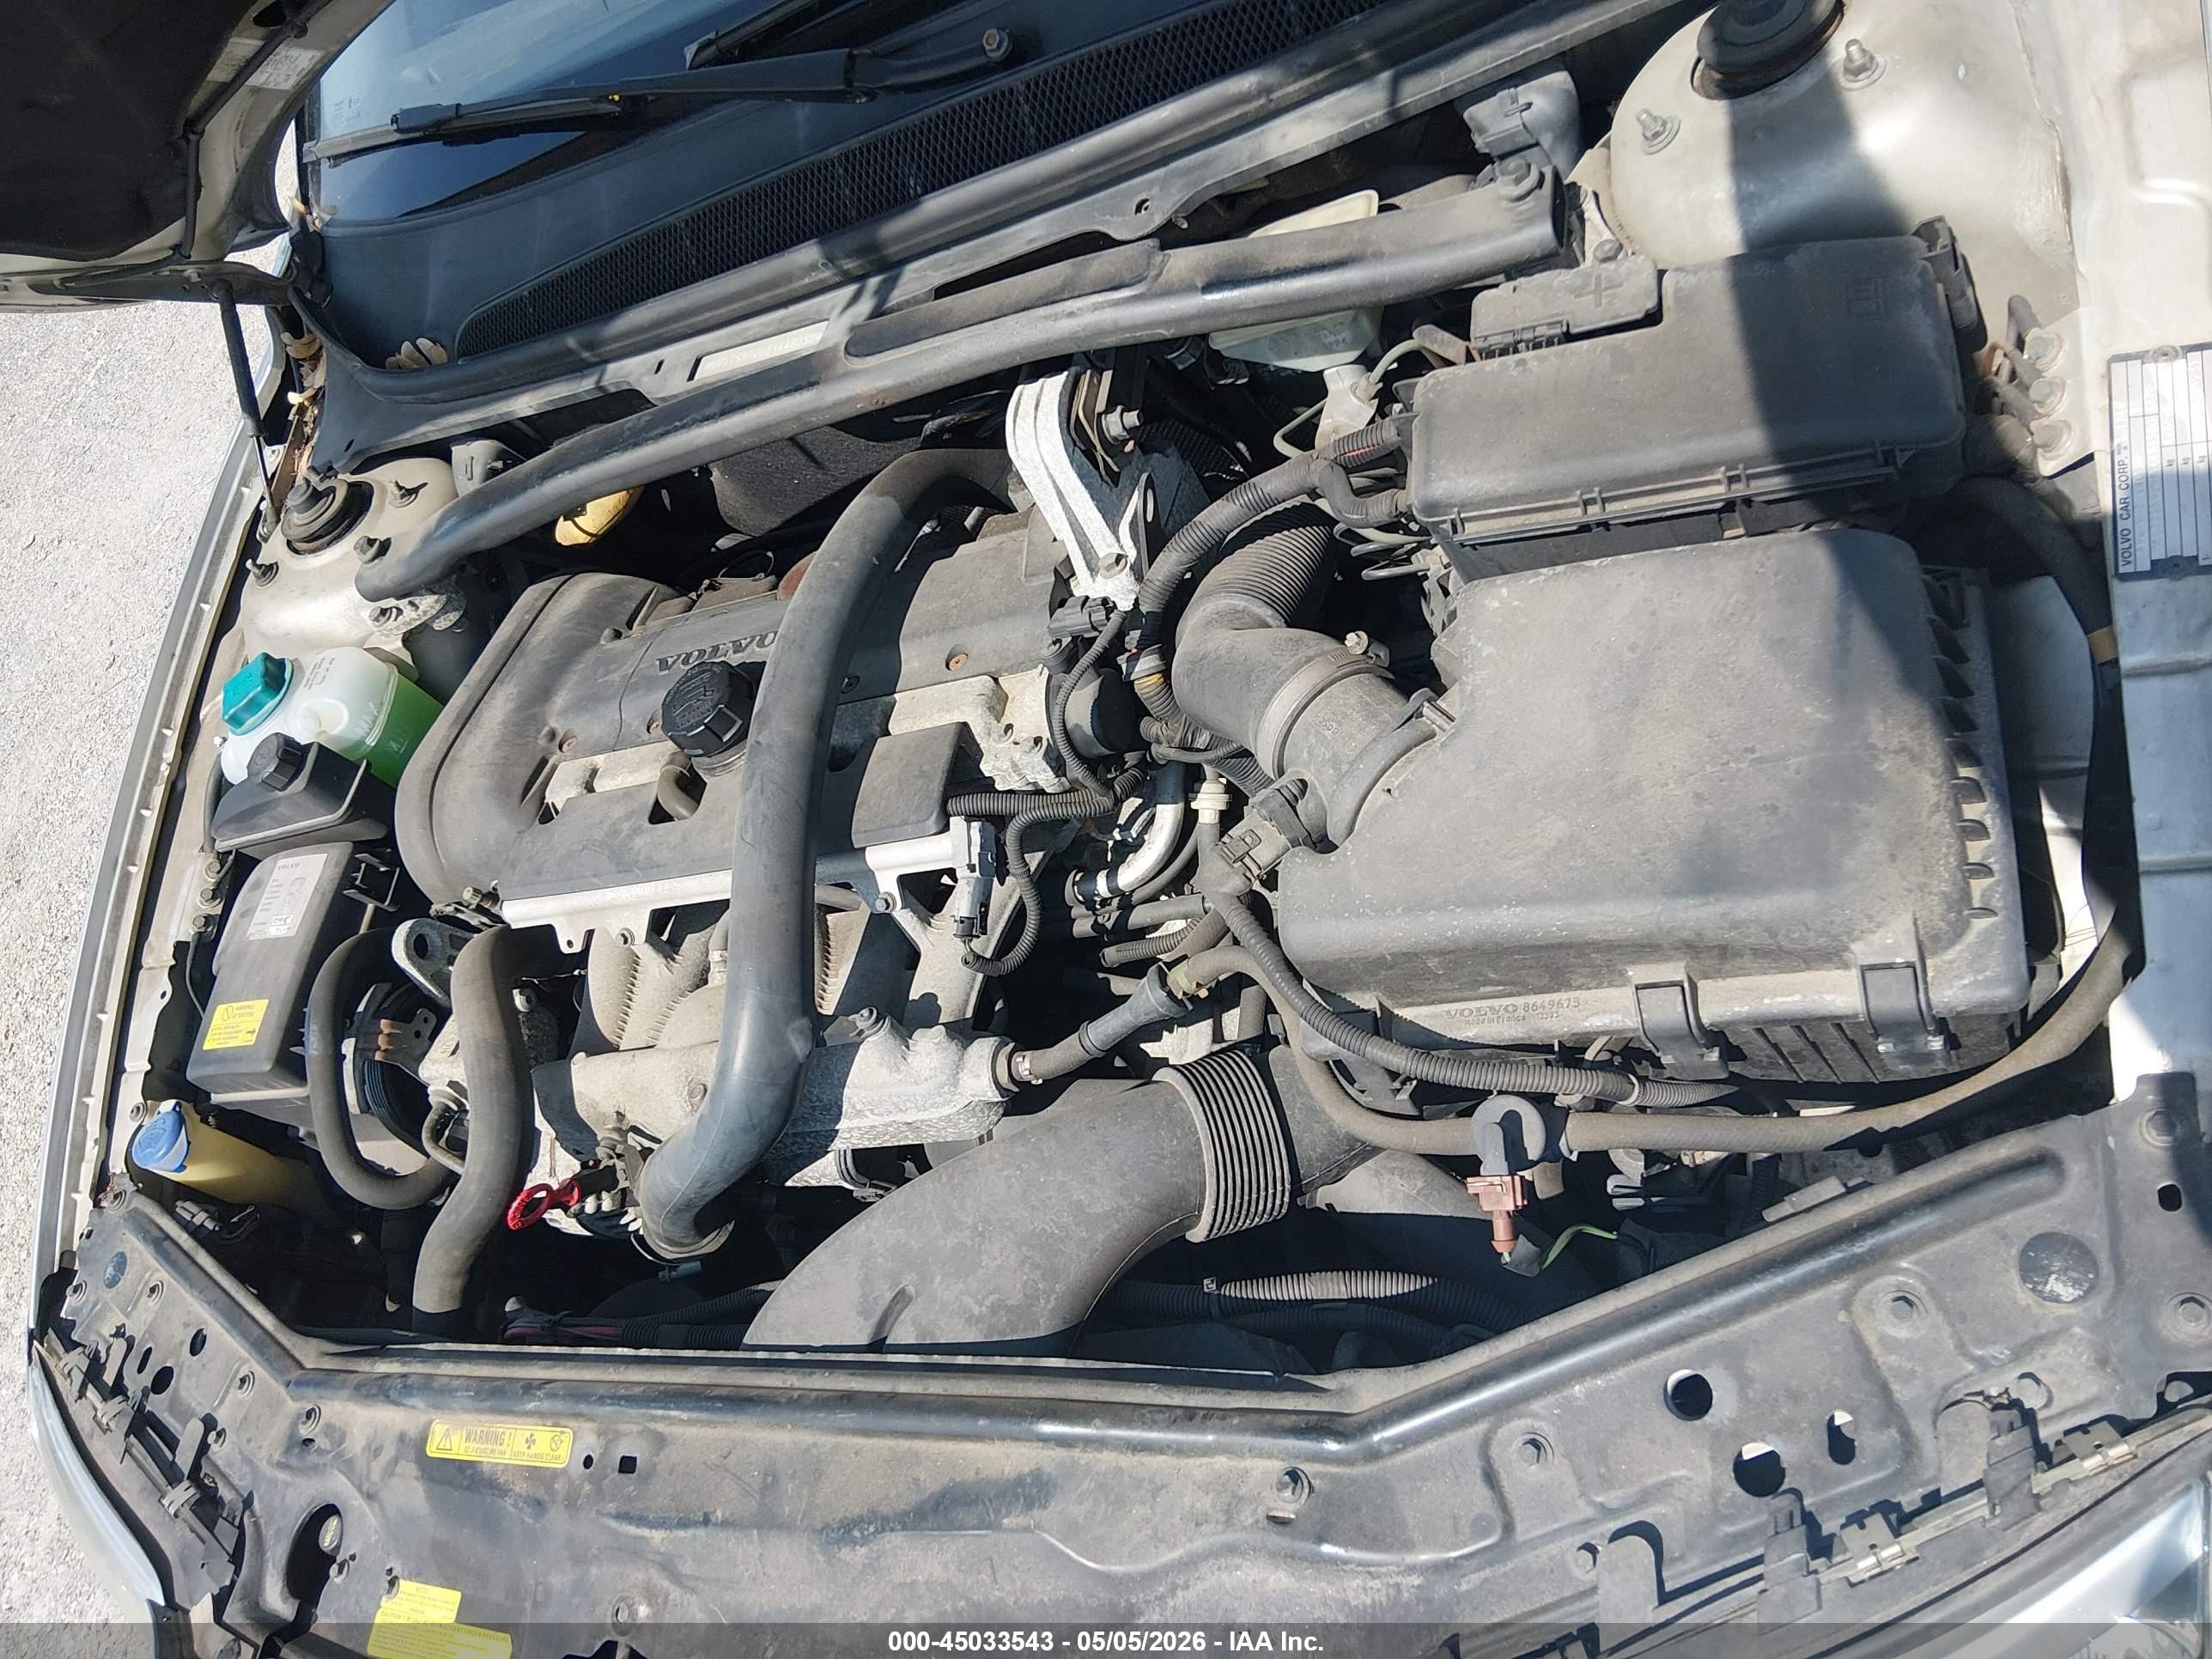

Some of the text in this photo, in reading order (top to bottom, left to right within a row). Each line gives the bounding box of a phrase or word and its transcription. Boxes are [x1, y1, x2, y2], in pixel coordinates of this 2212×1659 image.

[2119, 496, 2130, 520] CAR
[2120, 528, 2133, 568] VOLVO
[655, 630, 778, 674] VOLVO
[1313, 714, 1340, 736] BOSCH
[1443, 1003, 1519, 1020] VOLVO
[465, 1428, 505, 1446] WARNING
